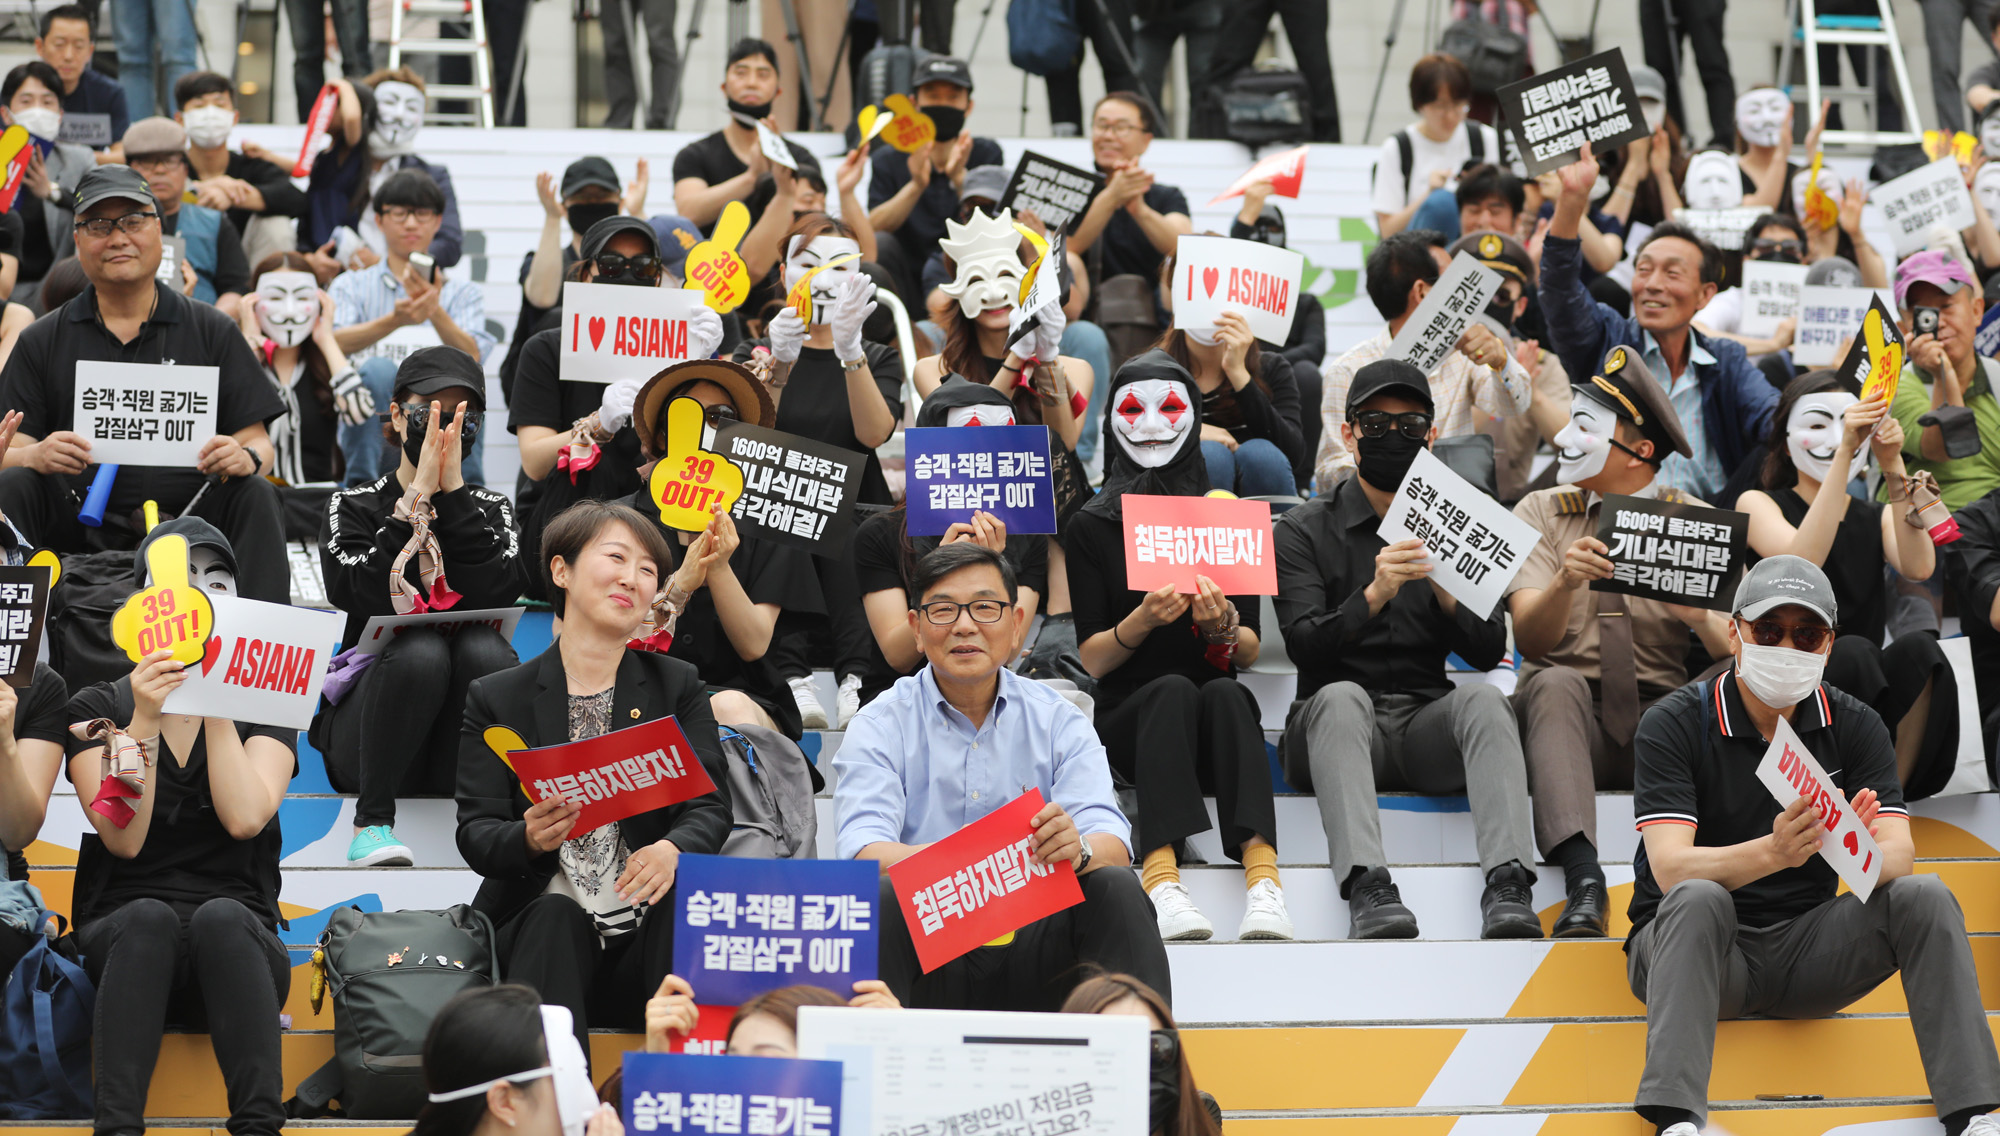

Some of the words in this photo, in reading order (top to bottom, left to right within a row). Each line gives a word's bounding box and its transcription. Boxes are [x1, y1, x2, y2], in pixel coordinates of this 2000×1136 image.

[1520, 66, 1613, 116] 즉각해결!
[1522, 87, 1627, 144] 기내식대란
[691, 261, 735, 306] OUT!
[713, 250, 740, 279] 39
[1187, 264, 1194, 301] I
[1227, 267, 1289, 317] ASIANA
[1445, 270, 1483, 313] 굶기는
[1464, 288, 1484, 315] OUT
[573, 313, 579, 352] I
[613, 316, 688, 359] ASIANA
[1878, 351, 1892, 380] 39
[82, 387, 154, 412] 승객·직원
[160, 390, 208, 414] 굶기는
[94, 417, 159, 441] 갑질삼구
[165, 419, 195, 442] OUT
[680, 455, 715, 484] 39
[731, 436, 783, 465] 1600억
[784, 448, 849, 483] 돌려주고
[914, 452, 994, 480] 승객·직원
[997, 451, 1046, 478] 굶기는
[661, 480, 726, 515] OUT!
[929, 483, 1001, 510] 갑질삼구
[1005, 482, 1036, 508] OUT
[1406, 476, 1471, 536] 승객·직원
[1464, 522, 1517, 570] 굶기는
[1615, 509, 1665, 535] 1600억
[1667, 517, 1732, 543] 돌려주고
[1134, 524, 1263, 566] 침묵하지말자!
[1403, 507, 1460, 562] 갑질삼구
[1455, 551, 1491, 586] OUT
[1608, 532, 1731, 572] 기내식대란
[1613, 562, 1720, 598] 즉각해결!
[142, 588, 176, 623] 39
[137, 609, 199, 657] OUT!
[223, 636, 316, 696] ASIANA
[687, 890, 795, 930] 승객·직원
[801, 894, 871, 931] 굶기는
[704, 935, 803, 973] 갑질삼구
[809, 938, 854, 973] OUT
[633, 1091, 743, 1134] 승객·직원
[748, 1094, 833, 1136] 굶기는
[1029, 1081, 1094, 1115] 저임금
